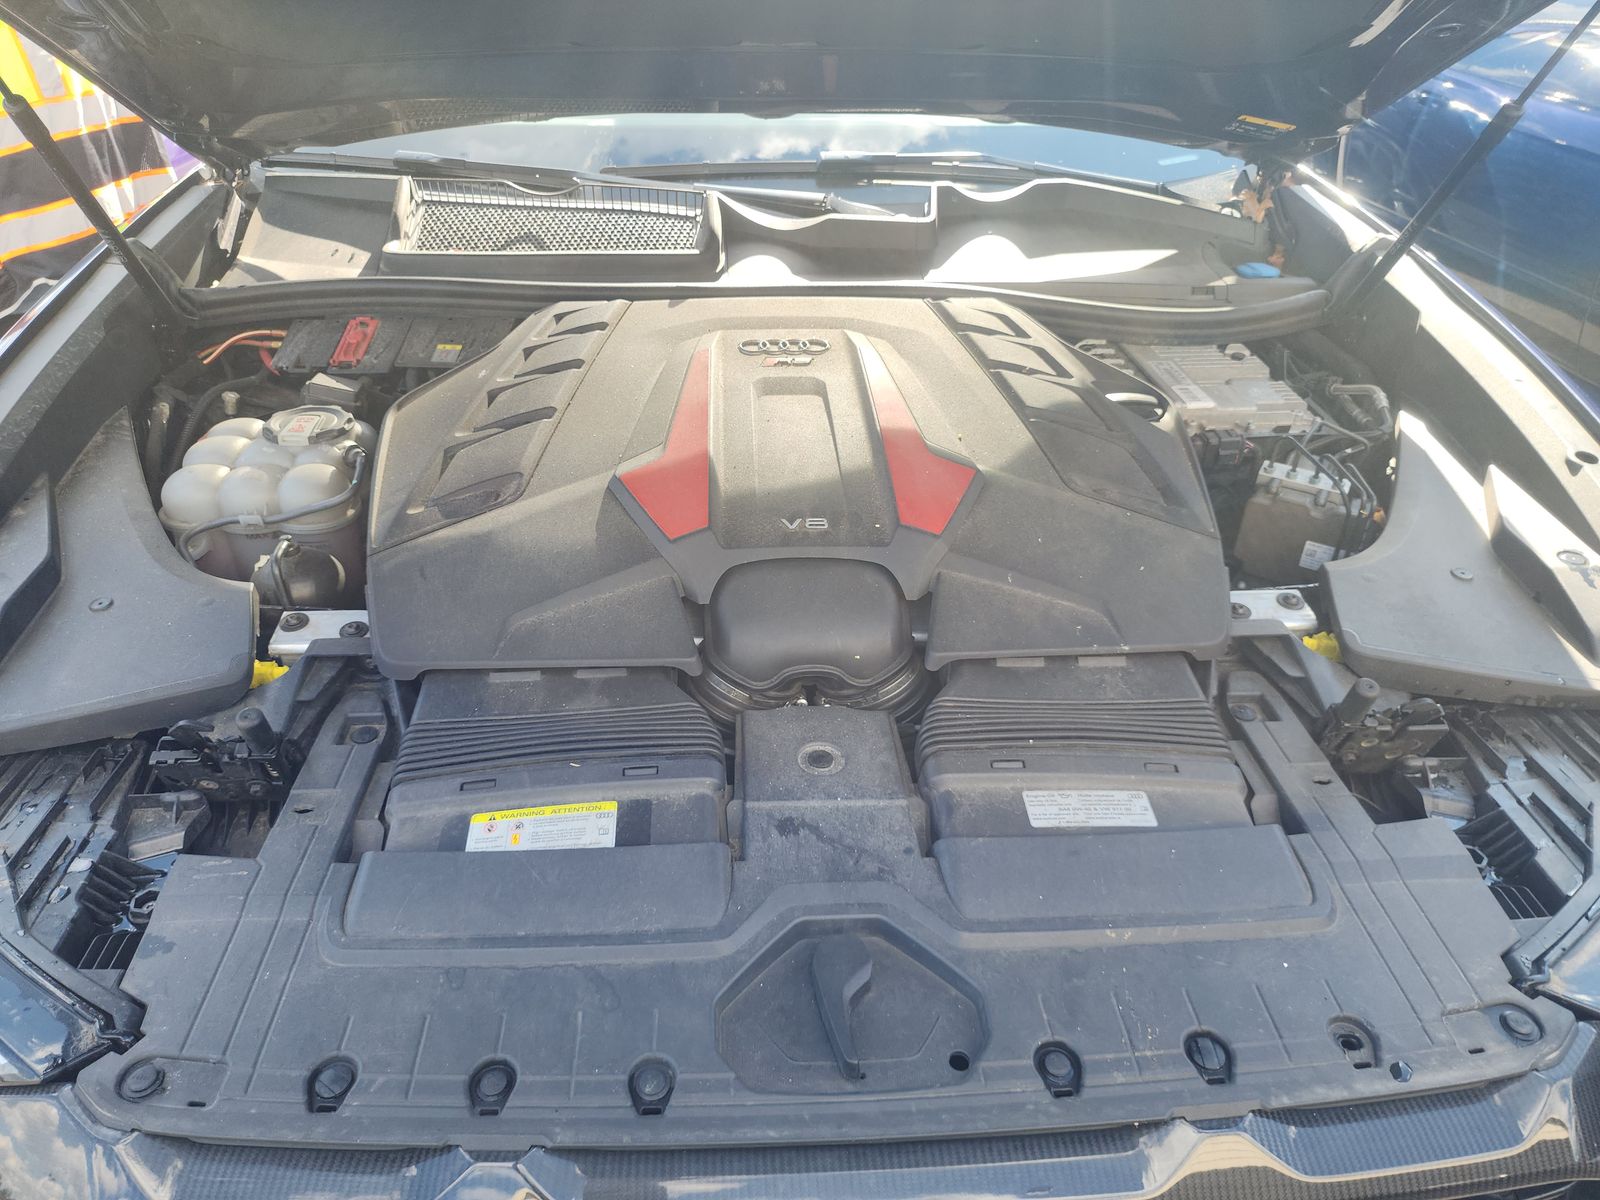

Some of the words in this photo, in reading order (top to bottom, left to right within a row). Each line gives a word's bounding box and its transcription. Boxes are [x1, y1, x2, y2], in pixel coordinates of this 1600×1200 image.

[780, 518, 828, 529] V8
[500, 809, 545, 820] WARNING
[550, 804, 603, 816] ATTENTION
